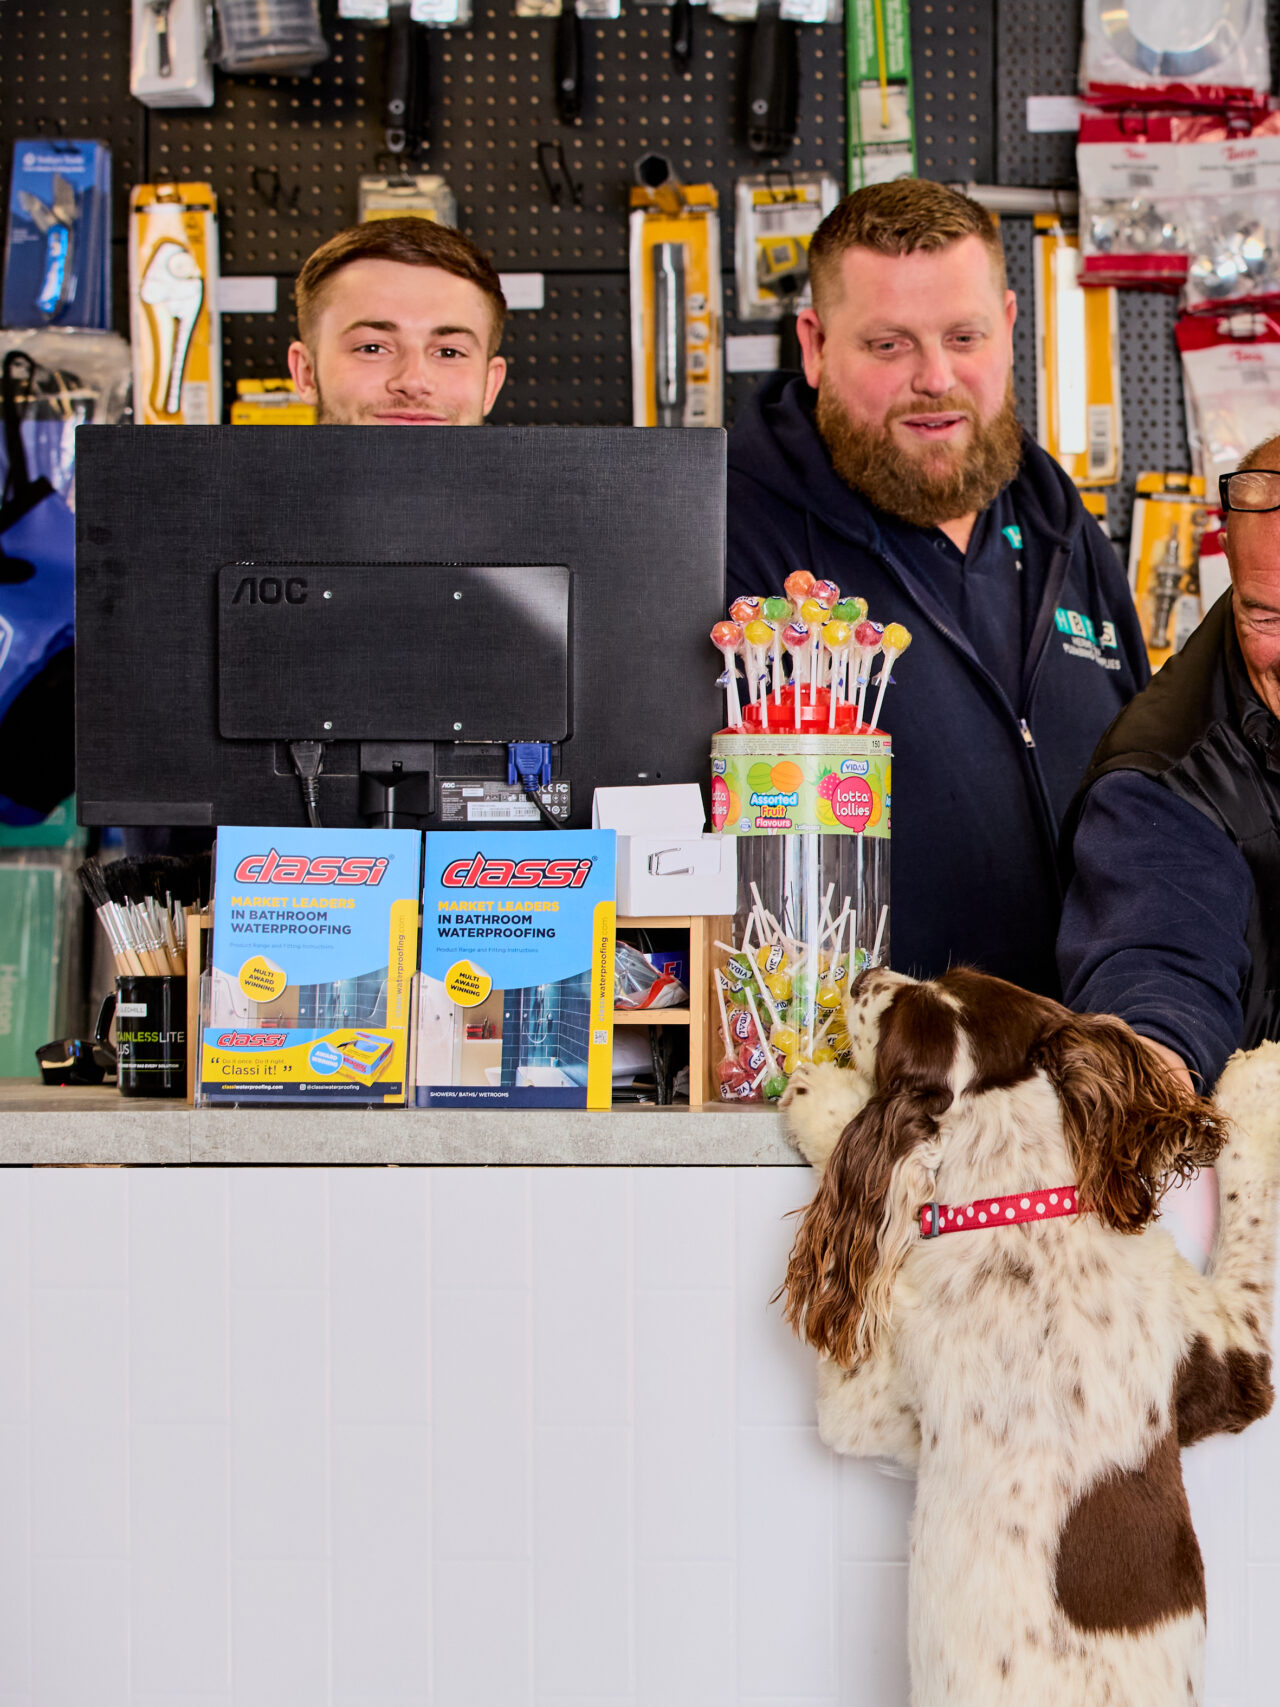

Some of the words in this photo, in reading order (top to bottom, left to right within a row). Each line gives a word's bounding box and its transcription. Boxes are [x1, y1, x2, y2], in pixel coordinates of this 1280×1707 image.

[231, 577, 309, 605] AOC
[845, 763, 866, 772] VIDAL
[750, 792, 798, 806] Assorted
[837, 789, 869, 802] lotta
[761, 805, 787, 817] Fruit
[836, 803, 870, 816] lollies
[755, 818, 792, 828] Flavours
[234, 847, 390, 887] classi
[441, 851, 593, 889] classi
[231, 896, 288, 908] MARKET
[292, 897, 356, 909] LEADERS
[438, 901, 494, 912] MARKET
[498, 901, 560, 912] LEADERS
[231, 909, 245, 920] IN
[249, 910, 328, 921] BATHROOM
[438, 914, 451, 925] IN
[455, 914, 533, 925] BATHROOM
[231, 923, 352, 935] WATERPROOFING
[438, 928, 556, 938] WATERPROOFING
[253, 968, 274, 978] MULTI
[459, 972, 480, 982] MULTI
[248, 974, 275, 985] AWARD
[454, 979, 480, 990] AWARD
[244, 980, 275, 992] WINNING
[450, 984, 480, 997] WINNING
[217, 1029, 288, 1048] classi
[222, 1065, 260, 1075] Classi
[264, 1065, 277, 1075] it!
